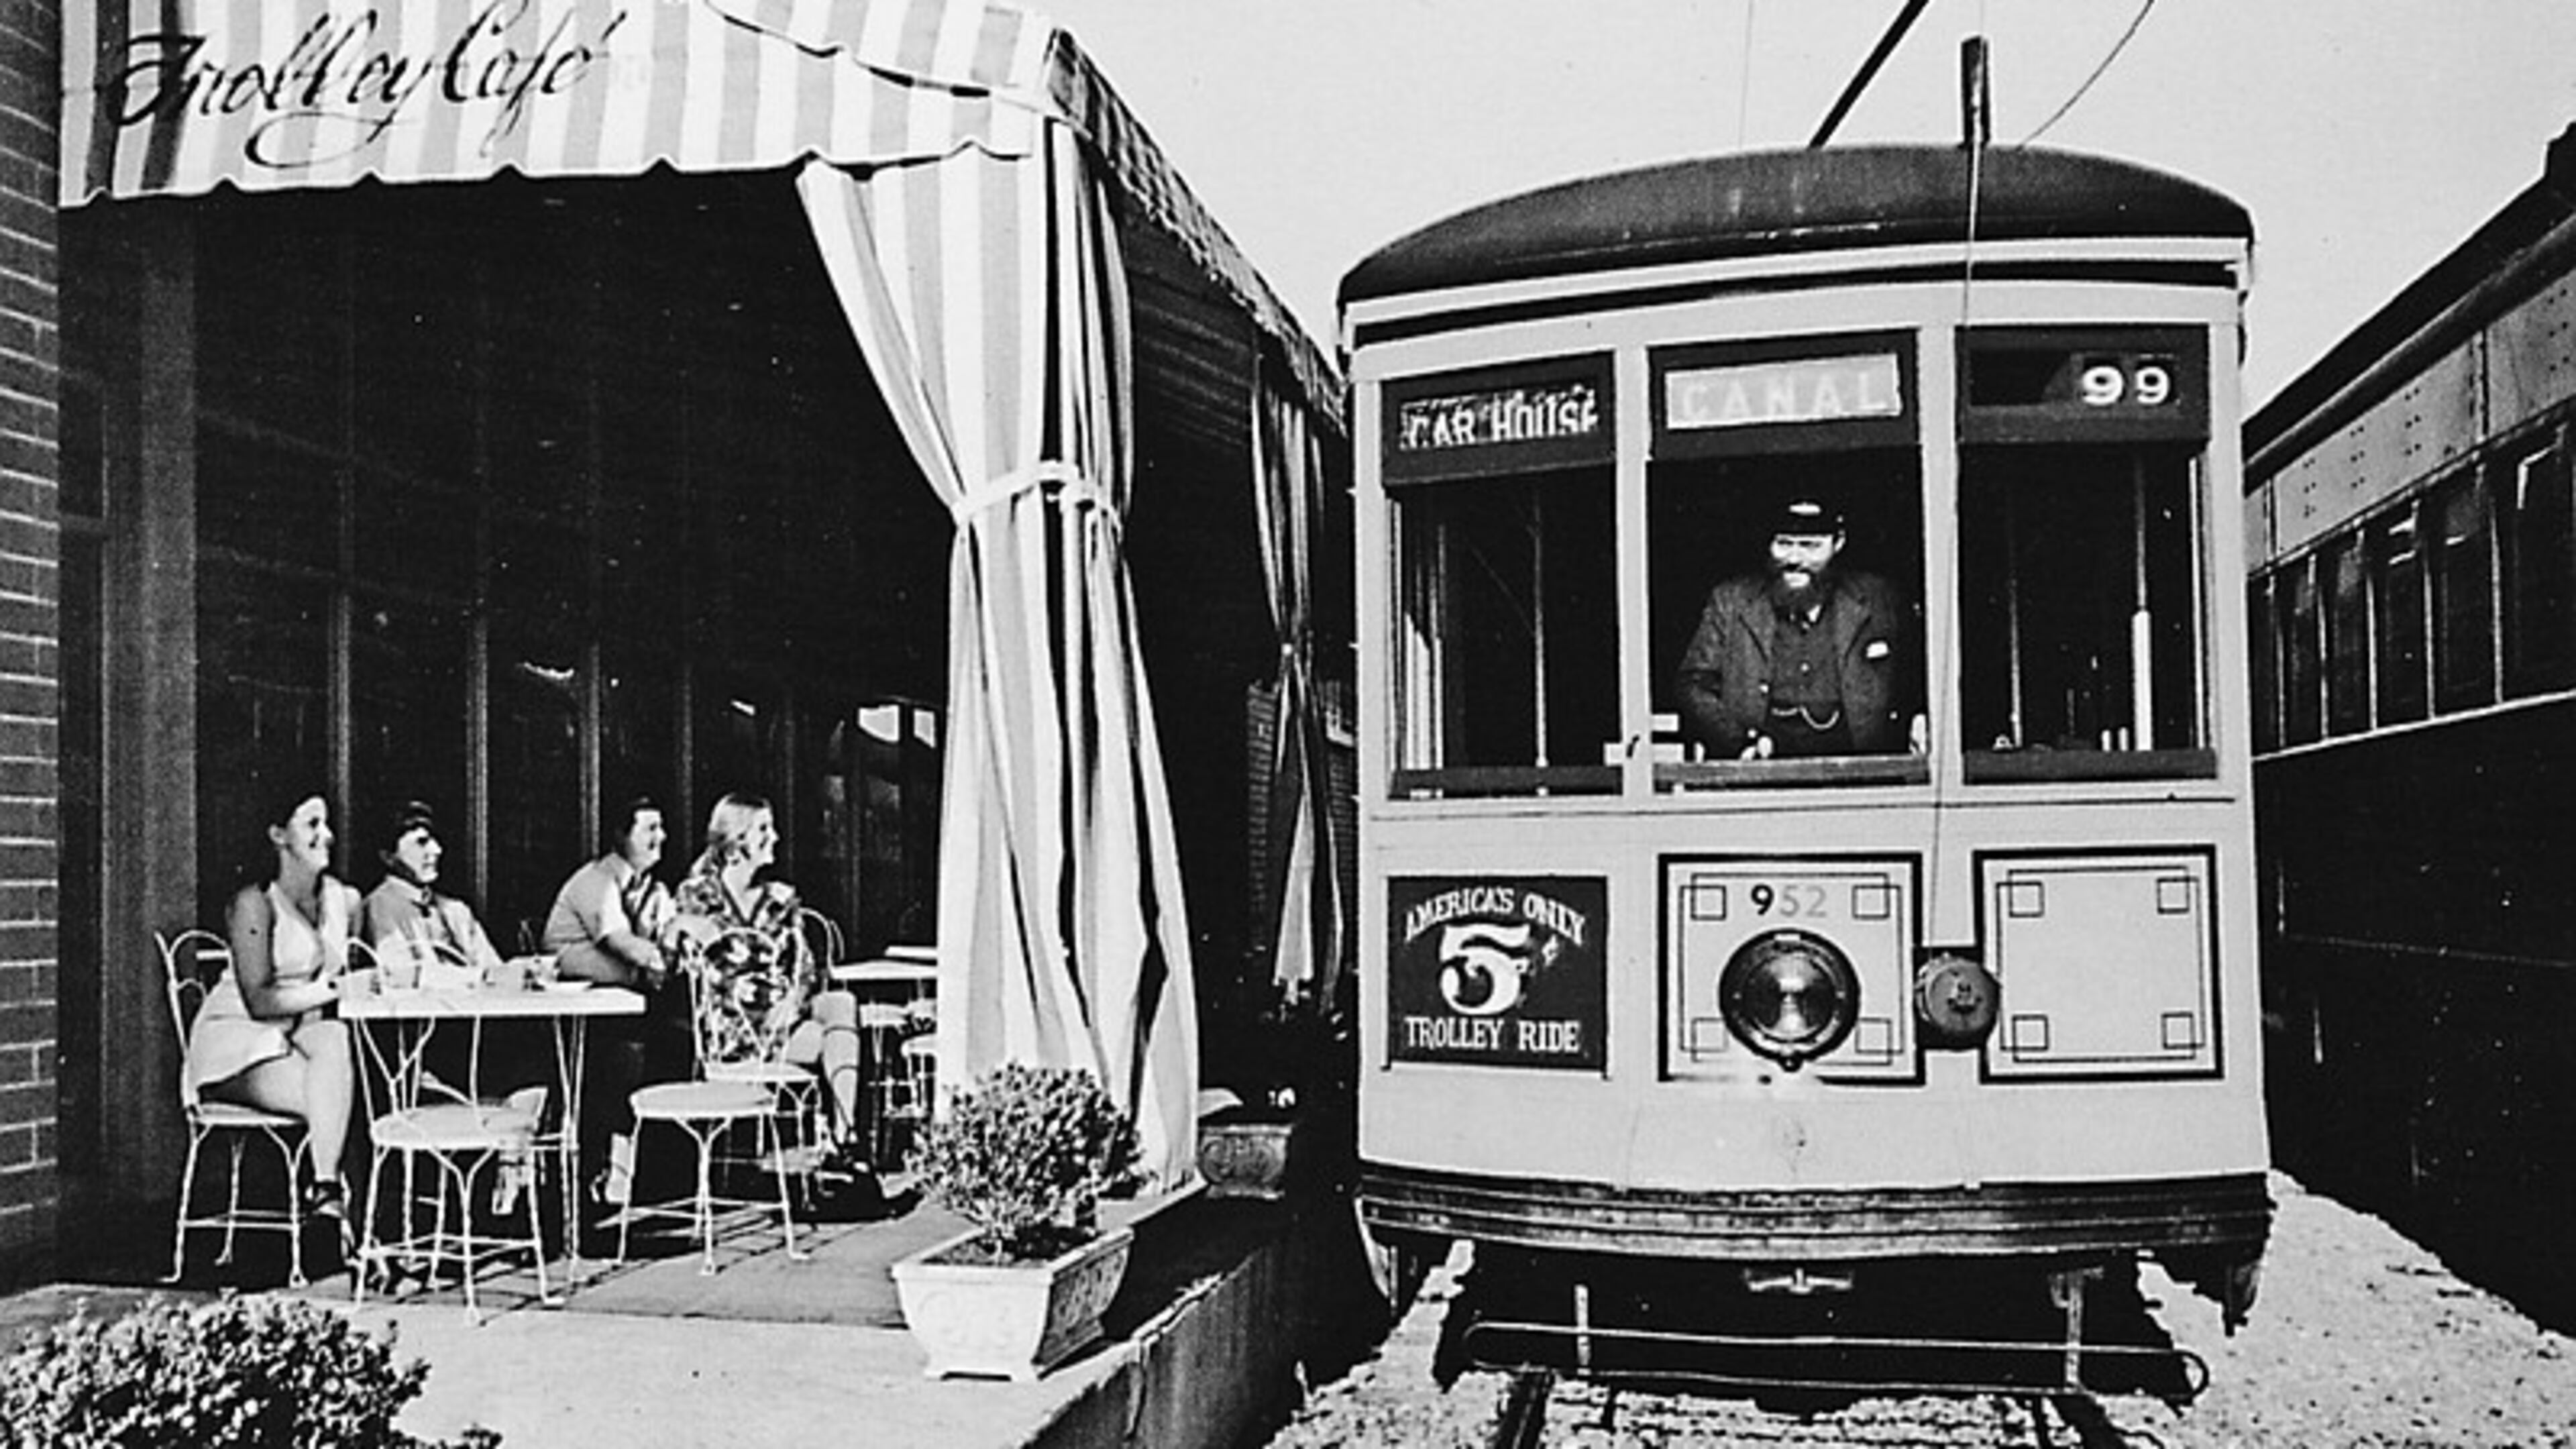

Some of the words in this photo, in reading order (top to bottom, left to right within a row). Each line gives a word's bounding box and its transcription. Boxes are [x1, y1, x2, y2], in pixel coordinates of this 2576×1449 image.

[106, 9, 435, 168] Trolley
[1682, 372, 1888, 421] CANAL
[2081, 365, 2171, 407] 99
[1405, 886, 1515, 943] AMERICA'S
[1522, 892, 1586, 946] ONLY
[1751, 883, 1827, 918] 952
[1404, 1016, 1505, 1051] TROLLEY
[1517, 1019, 1580, 1053] RIDE
